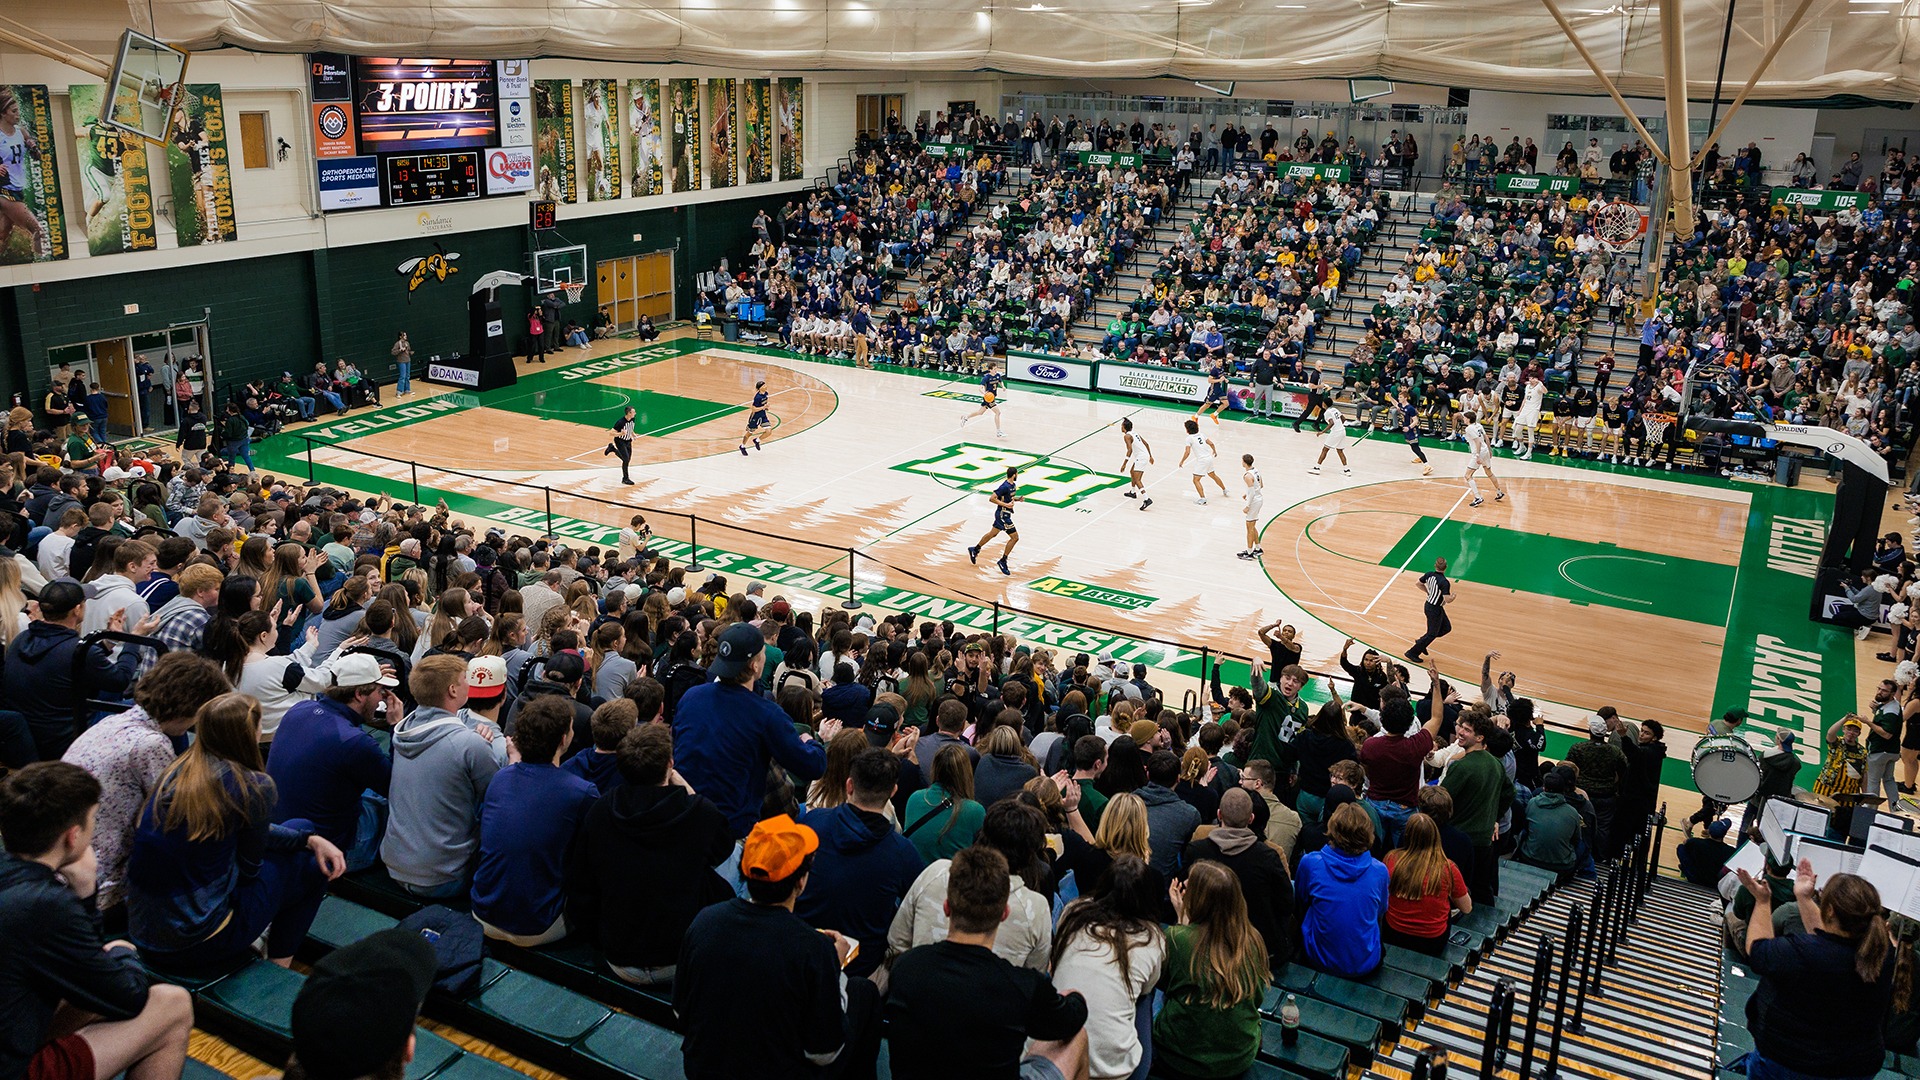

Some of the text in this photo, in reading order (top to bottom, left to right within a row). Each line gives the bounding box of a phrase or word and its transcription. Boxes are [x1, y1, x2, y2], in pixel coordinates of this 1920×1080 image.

[377, 80, 479, 112] 3 POINTS
[562, 83, 572, 115] RODEO
[564, 117, 575, 161] WOMEN'S
[763, 86, 772, 177] TRIATHLON
[96, 136, 118, 159] 43
[558, 138, 567, 167] JACKET
[203, 95, 235, 235] WOMEN'S GOLF
[423, 156, 447, 168] 14:38
[465, 165, 474, 176] 10
[488, 151, 531, 184] Queen
[1120, 156, 1135, 166] 102
[1289, 166, 1300, 175] A2
[29, 158, 44, 205] JACKET
[40, 152, 56, 194] CROSS
[322, 168, 363, 176] ORTHOPEDICS
[322, 173, 376, 182] SPORTS MEDICINE
[399, 170, 409, 181] 13
[1324, 168, 1341, 178] 103
[567, 172, 577, 202] MEN'S
[1510, 179, 1522, 187] A2
[1550, 180, 1570, 191] 104
[537, 203, 555, 212] 14:38
[1786, 193, 1801, 203] A2
[1834, 195, 1857, 207] 105
[203, 189, 219, 236] YELLOW
[422, 213, 452, 227] Sundance
[536, 212, 552, 228] 28
[46, 195, 64, 257] WOMEN'S
[558, 347, 682, 381] JACKETS
[1035, 365, 1060, 380] Ford
[439, 368, 464, 381] DANA
[1120, 375, 1198, 395] YELLOW JACKETS
[303, 398, 460, 440] YELLOW
[1774, 424, 1808, 434] SPALDING
[1197, 437, 1203, 445] 2
[890, 443, 1130, 507] BH
[1766, 515, 1825, 579] YELLOW
[487, 507, 1203, 670] BLACK ILLS STATE UNIVERSITY
[1033, 578, 1154, 609] A2 ARENA
[477, 672, 486, 684] P
[1745, 633, 1823, 766] JACKETS
